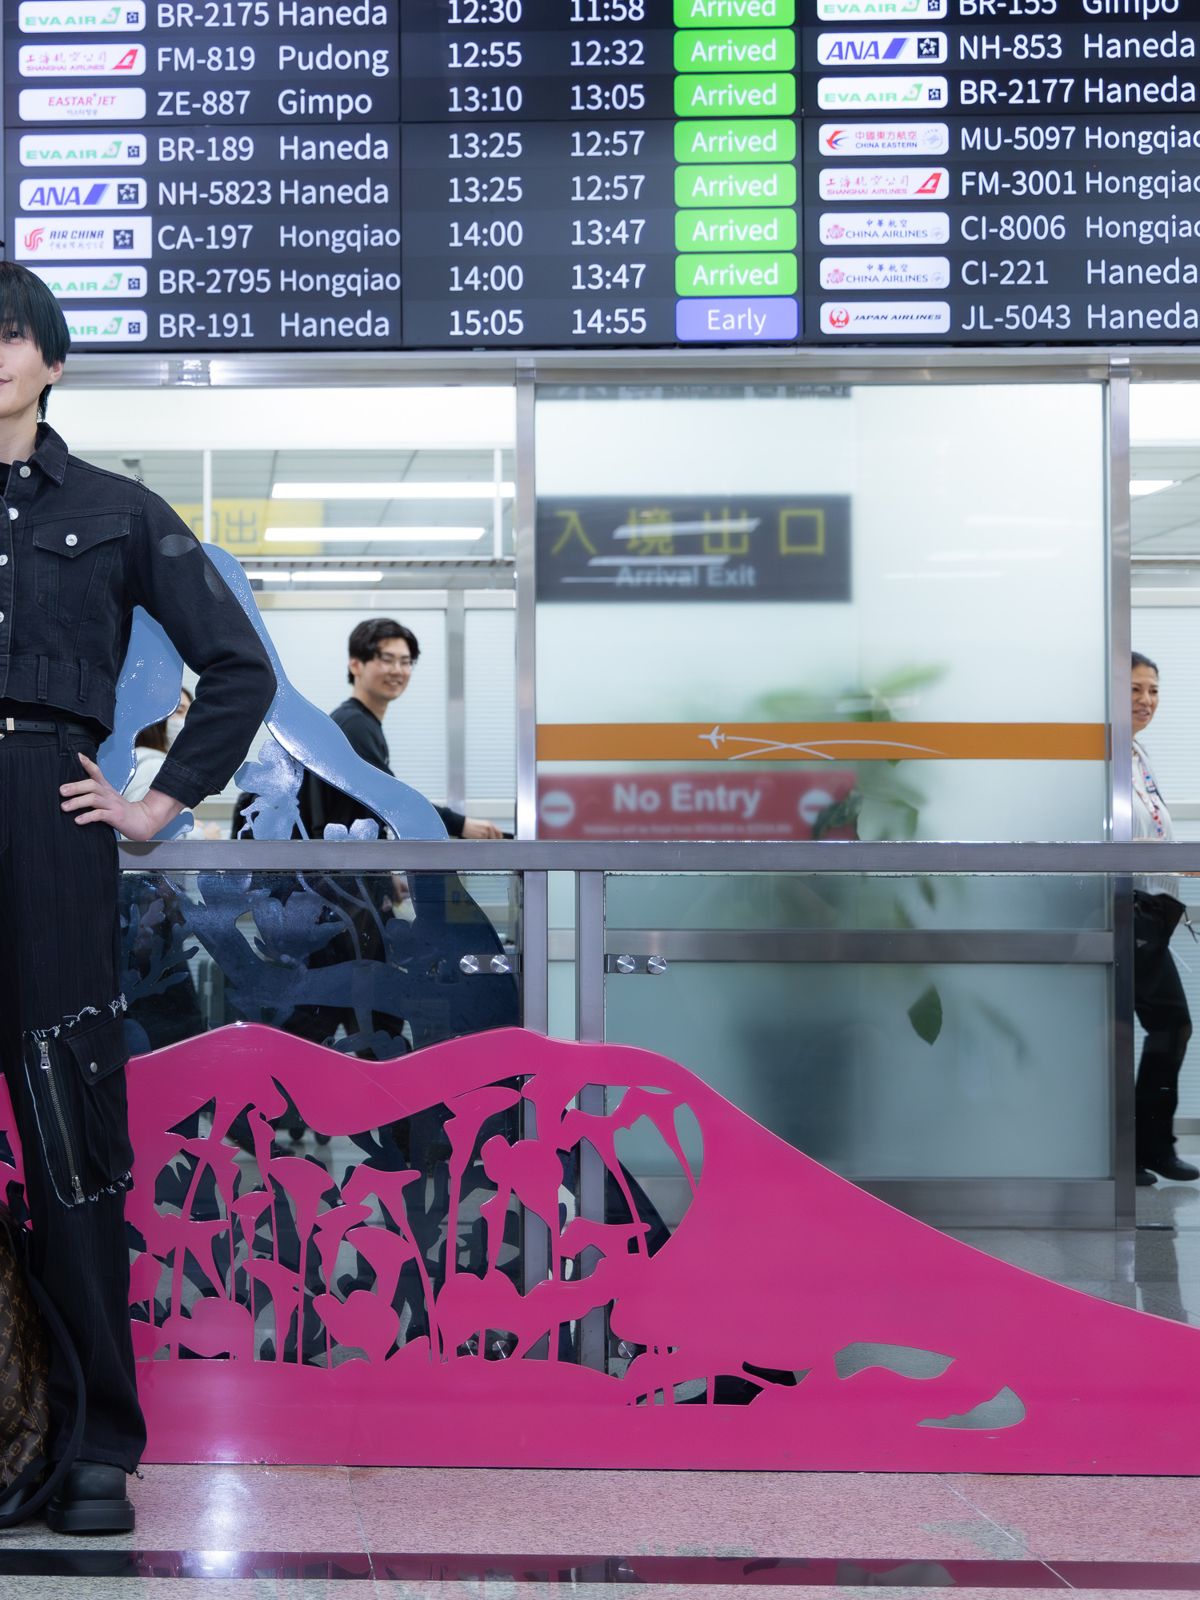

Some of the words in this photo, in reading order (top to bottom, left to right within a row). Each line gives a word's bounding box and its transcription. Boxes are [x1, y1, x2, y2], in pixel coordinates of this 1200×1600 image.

[157, 1, 270, 28] BR-2175
[278, 0, 388, 27] Haneda
[448, 0, 522, 24] 12:30
[570, 0, 645, 22] 11:58
[690, 0, 776, 17] Arrived
[959, 0, 1057, 16] BR-155
[1082, 0, 1179, 20] Gimpo
[157, 45, 256, 72] FM-819
[279, 43, 390, 76] Pudong
[448, 41, 522, 68] 12:55
[570, 39, 645, 66] 12:32
[691, 38, 777, 62] Arrived
[826, 41, 880, 60] ANA
[959, 33, 1063, 60] NH-853
[1084, 30, 1196, 59] Haneda
[156, 90, 251, 116] ZE-887
[277, 88, 373, 120] Gimpo
[448, 85, 523, 112] 13:10
[570, 83, 645, 111] 13:05
[691, 82, 777, 106] Arrived
[960, 78, 1075, 105] BR-2177
[1084, 74, 1197, 104] Haneda
[158, 136, 254, 162] BR-189
[279, 133, 389, 161] Haneda
[448, 132, 523, 159] 13:25
[570, 130, 645, 157] 12:57
[691, 128, 777, 153] Arrived
[961, 126, 1076, 151] MU-5097
[28, 186, 81, 206] ANA
[158, 180, 272, 206] NH-5823
[280, 177, 389, 205] Haneda
[448, 176, 523, 203] 13:25
[571, 174, 646, 201] 12:57
[691, 173, 778, 198] Arrived
[961, 170, 1077, 196] FM-3001
[49, 230, 68, 240] AIR
[71, 230, 104, 240] CHINA
[157, 224, 254, 251] CA-197
[280, 223, 401, 254] Hongqiao
[449, 220, 523, 247] 14:00
[571, 219, 646, 246] 13:47
[692, 218, 779, 242] Arrived
[845, 230, 879, 239] CHINA
[882, 230, 928, 239] AIRLINES
[960, 214, 1066, 241] CI-8006
[159, 268, 271, 294] BR-2795
[280, 267, 401, 298] Hongqiao
[449, 264, 524, 292] 14:00
[571, 263, 647, 290] 13:47
[692, 262, 779, 286] Arrived
[846, 275, 879, 283] CHINA
[882, 274, 928, 283] AIRLINES
[961, 259, 1049, 286] CI-221
[1087, 256, 1198, 285] Haneda
[159, 312, 254, 338] BR-191
[280, 309, 390, 338] Haneda
[449, 309, 524, 336] 15:05
[572, 307, 647, 335] 14:55
[707, 307, 767, 334] Early
[961, 304, 1071, 330] JL-5043
[1087, 301, 1199, 330] Haneda
[551, 507, 825, 557] 入境出口
[615, 565, 699, 588] Arrival
[706, 565, 756, 588] Exit
[612, 783, 660, 813] No
[670, 783, 762, 818] Entry
